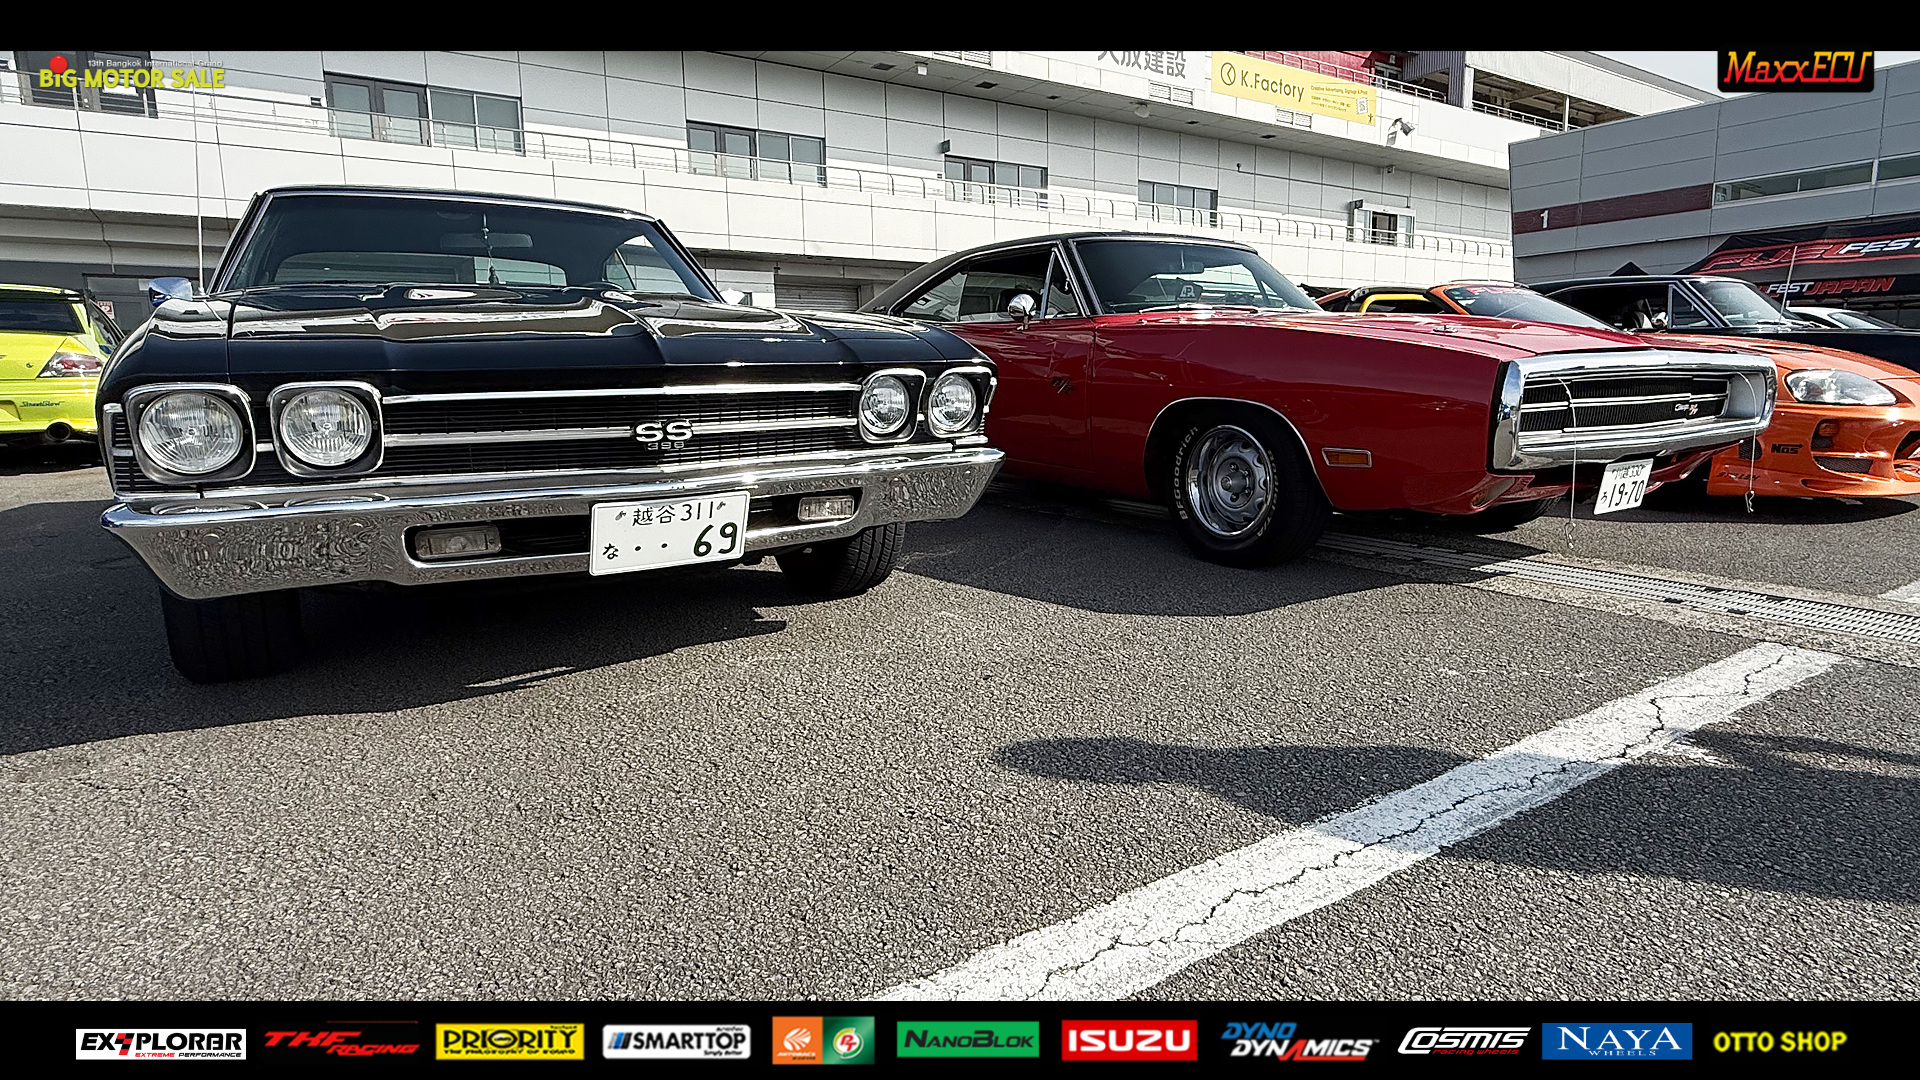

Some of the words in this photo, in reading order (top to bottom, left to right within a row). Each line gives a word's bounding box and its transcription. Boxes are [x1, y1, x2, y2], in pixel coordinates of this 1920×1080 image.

[1240, 69, 1305, 102] K.Factory
[1540, 209, 1549, 229] 1
[636, 421, 692, 442] SS
[602, 543, 619, 560] な
